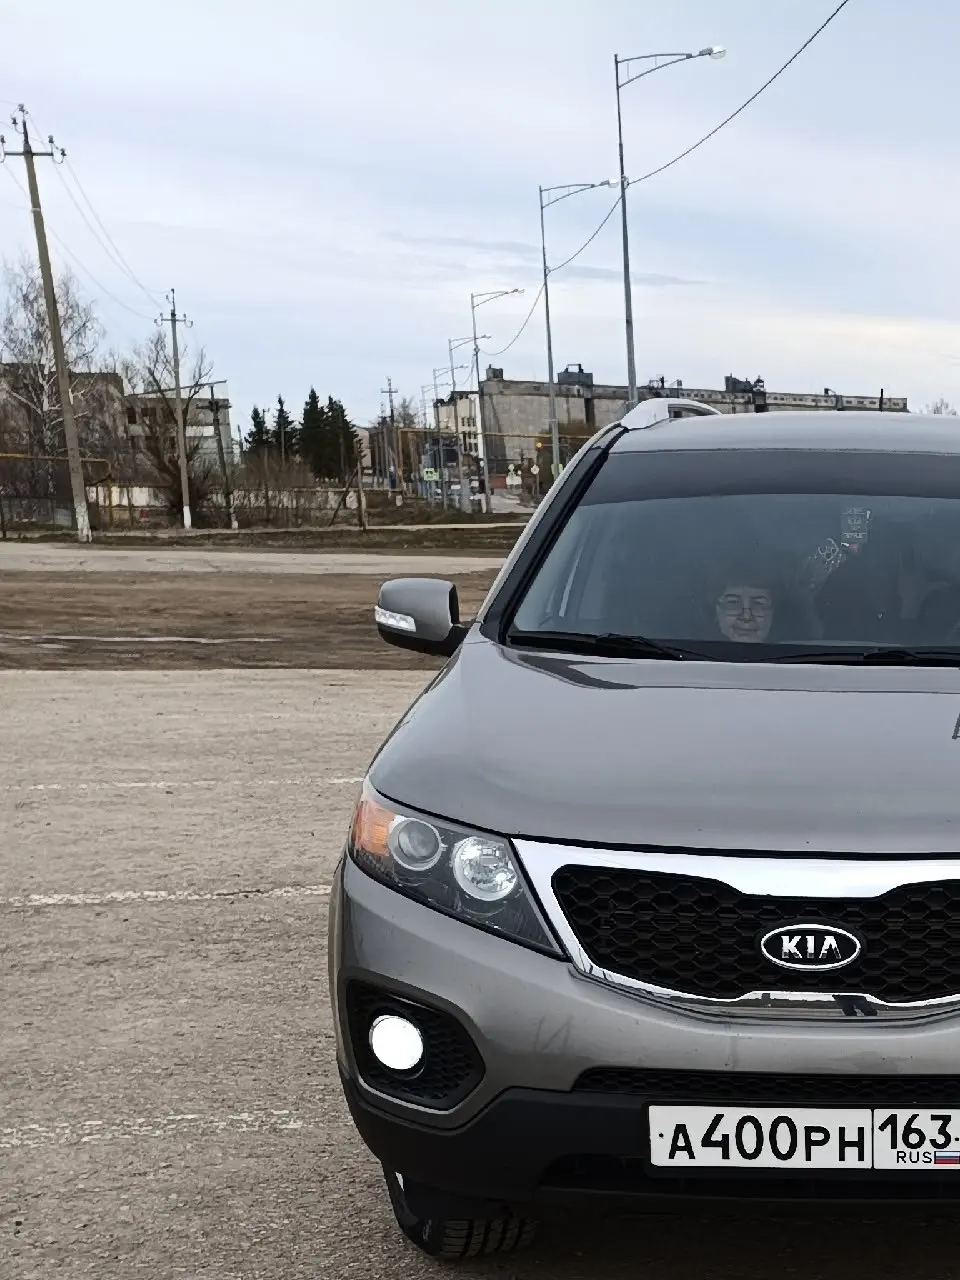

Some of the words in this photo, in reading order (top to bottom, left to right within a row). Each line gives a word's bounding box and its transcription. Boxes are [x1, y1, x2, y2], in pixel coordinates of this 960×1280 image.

[781, 935, 842, 959] KIA
[878, 1113, 951, 1150] 163
[896, 1151, 933, 1164] RUS
